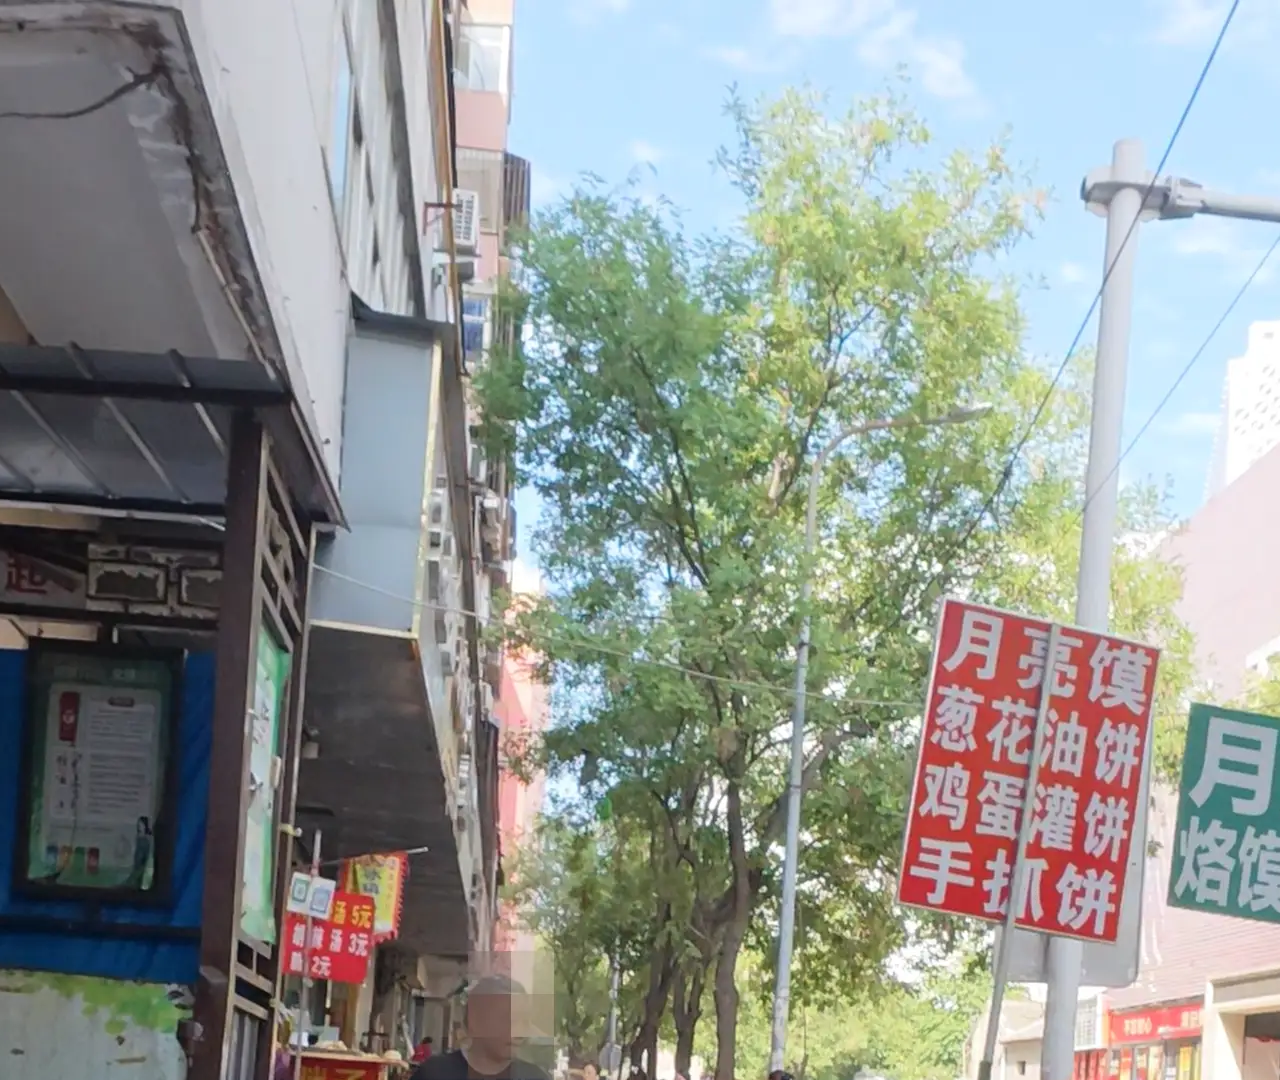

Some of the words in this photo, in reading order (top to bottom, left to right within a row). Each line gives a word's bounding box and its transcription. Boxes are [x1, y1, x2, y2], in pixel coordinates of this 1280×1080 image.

[943, 609, 1154, 717] 月亮馍
[930, 684, 1142, 788] 葱花油饼
[918, 763, 1129, 863] 鸡蛋灌饼
[910, 839, 1119, 938] 手抓饼
[311, 955, 332, 978] 2元
[348, 932, 370, 957] 3元
